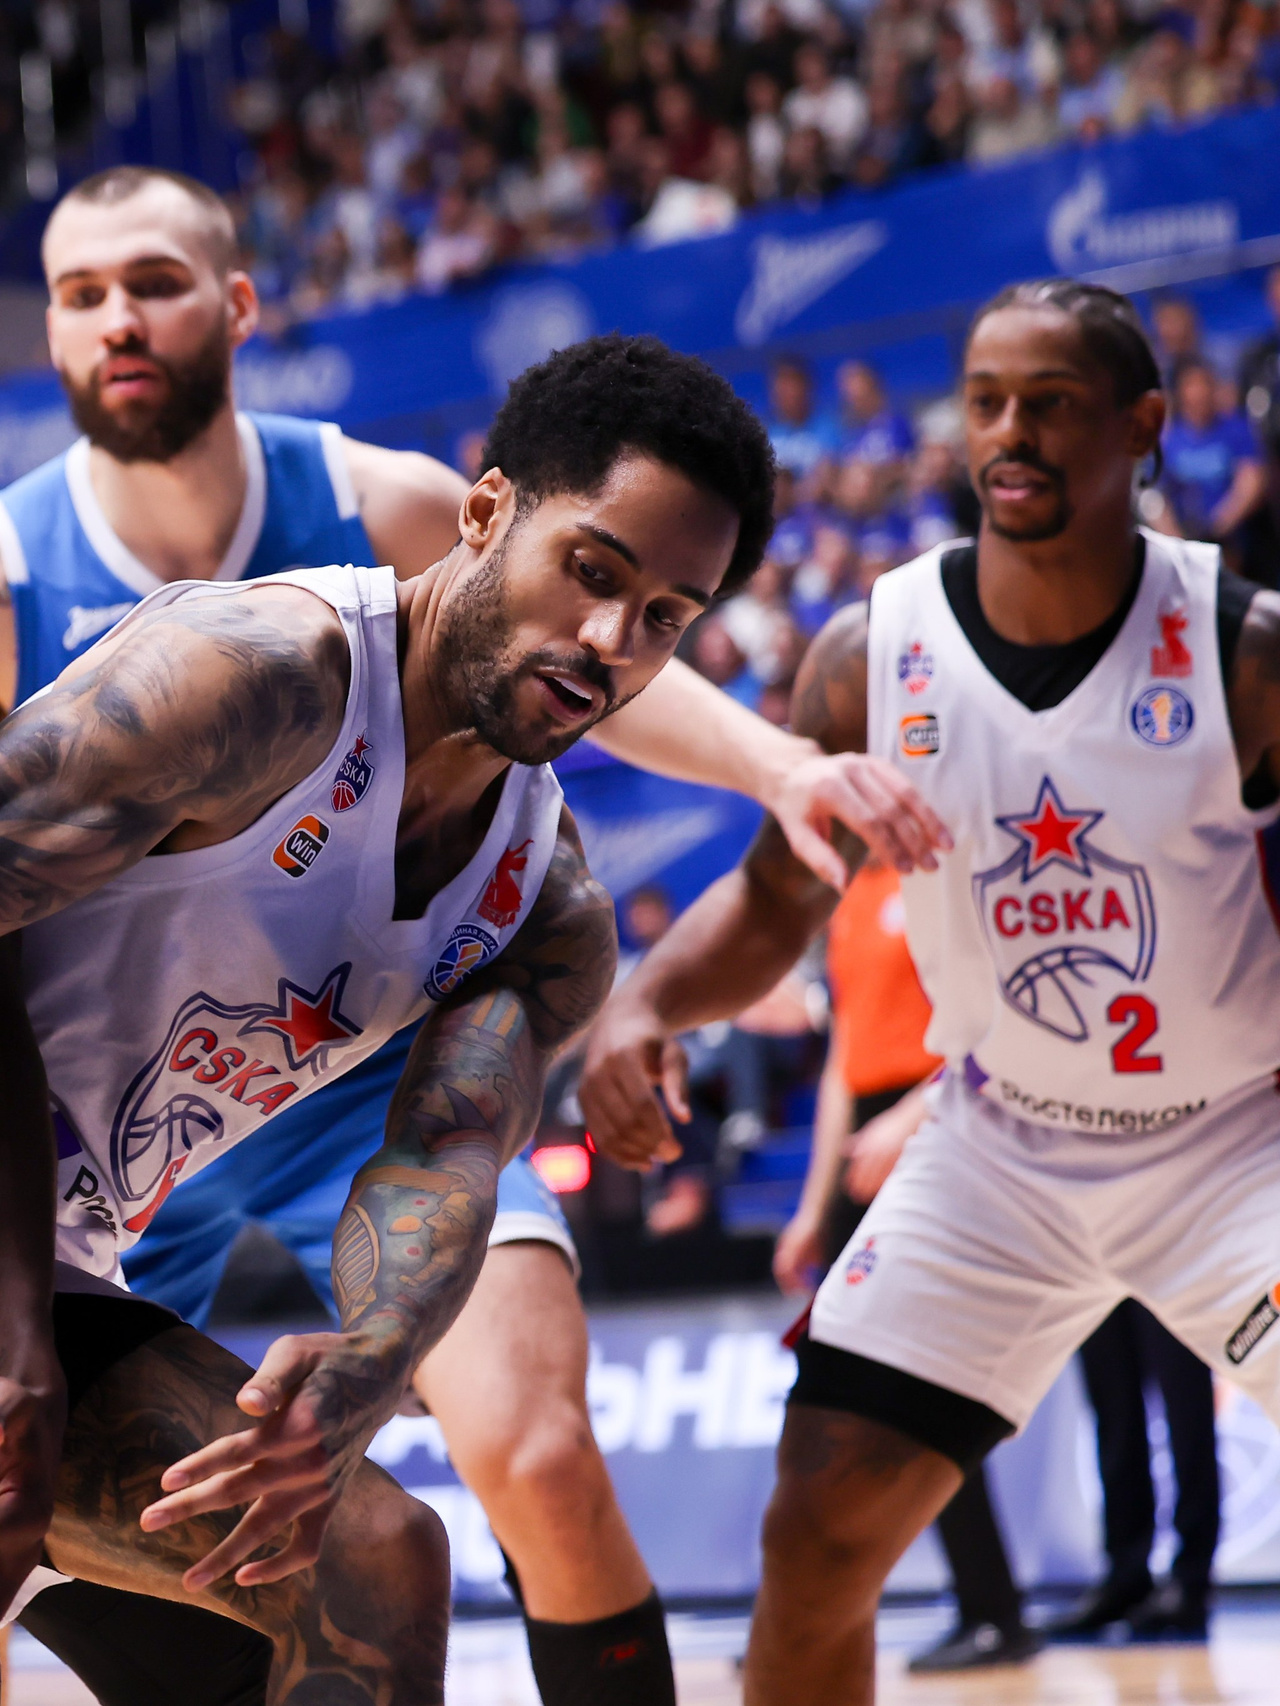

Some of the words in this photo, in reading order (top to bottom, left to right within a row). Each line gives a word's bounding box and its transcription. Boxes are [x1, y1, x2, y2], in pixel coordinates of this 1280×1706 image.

[338, 758, 366, 787] CSKA
[290, 832, 318, 864] Win
[994, 887, 1132, 939] CSKA
[1105, 993, 1165, 1075] 2
[168, 1027, 300, 1117] CSKA
